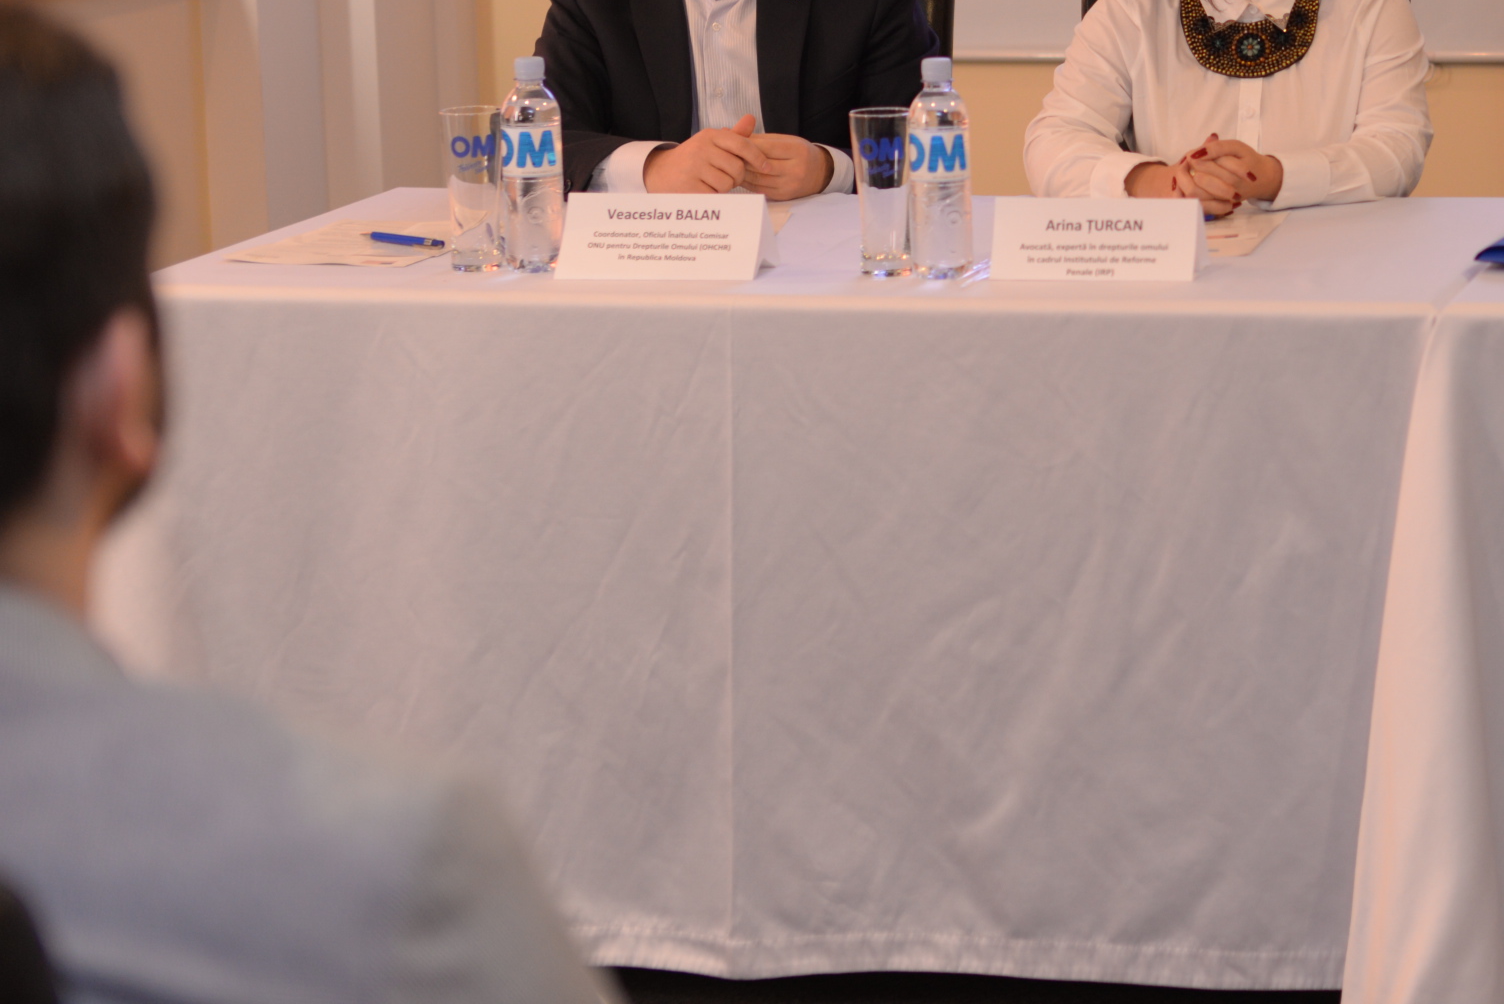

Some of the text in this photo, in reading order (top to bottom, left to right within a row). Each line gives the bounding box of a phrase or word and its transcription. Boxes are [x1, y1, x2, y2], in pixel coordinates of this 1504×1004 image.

[451, 134, 496, 158] OM
[859, 136, 904, 161] OM
[607, 209, 720, 221] Veaceslav BALAN
[1045, 219, 1143, 234] Arina ȚURCAN
